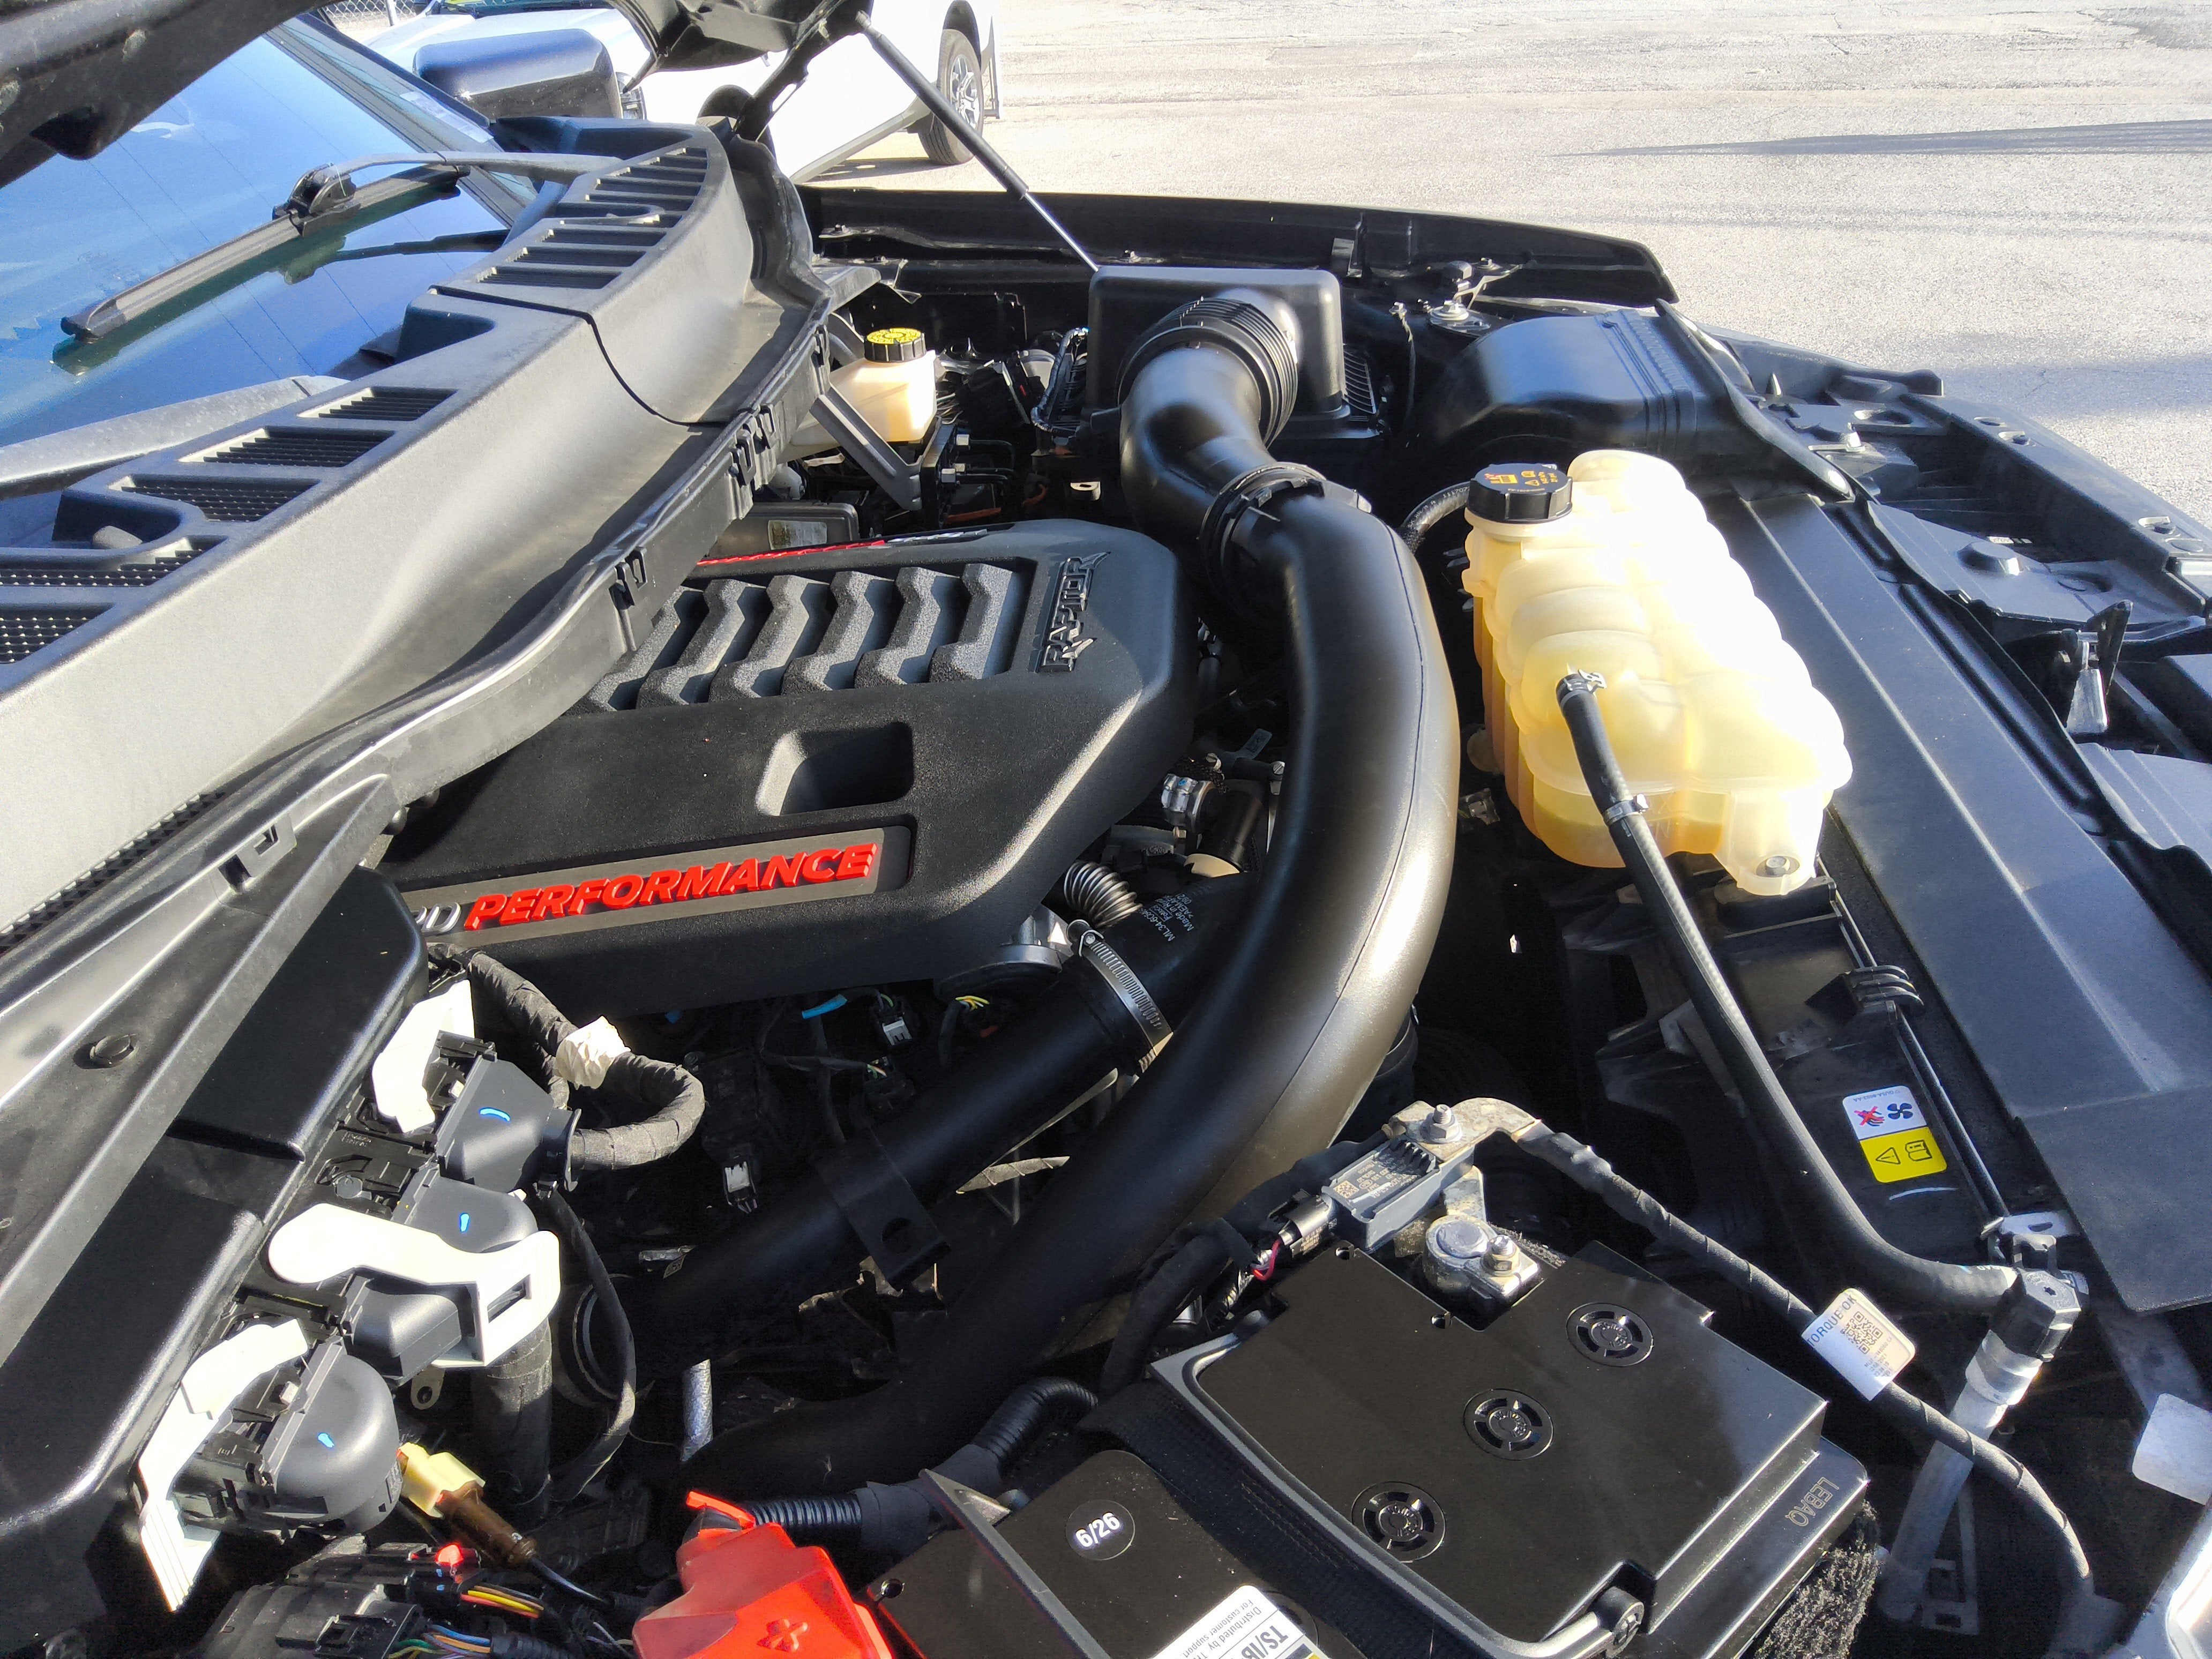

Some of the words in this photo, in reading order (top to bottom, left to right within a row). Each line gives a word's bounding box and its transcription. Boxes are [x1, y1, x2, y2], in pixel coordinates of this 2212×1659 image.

[1043, 552, 1111, 671] RAPTOR
[464, 843, 878, 930] PERFORMANCE
[1176, 911, 1194, 931] Made
[1807, 1309, 1844, 1346] TORQUE
[1842, 1295, 1857, 1311] OK
[1784, 1477, 1840, 1527] LEBAQ
[1075, 1511, 1120, 1548] 6/26
[1210, 1609, 1240, 1636] customer
[1240, 1599, 1254, 1611] For
[1219, 1606, 1262, 1643] Distributed
